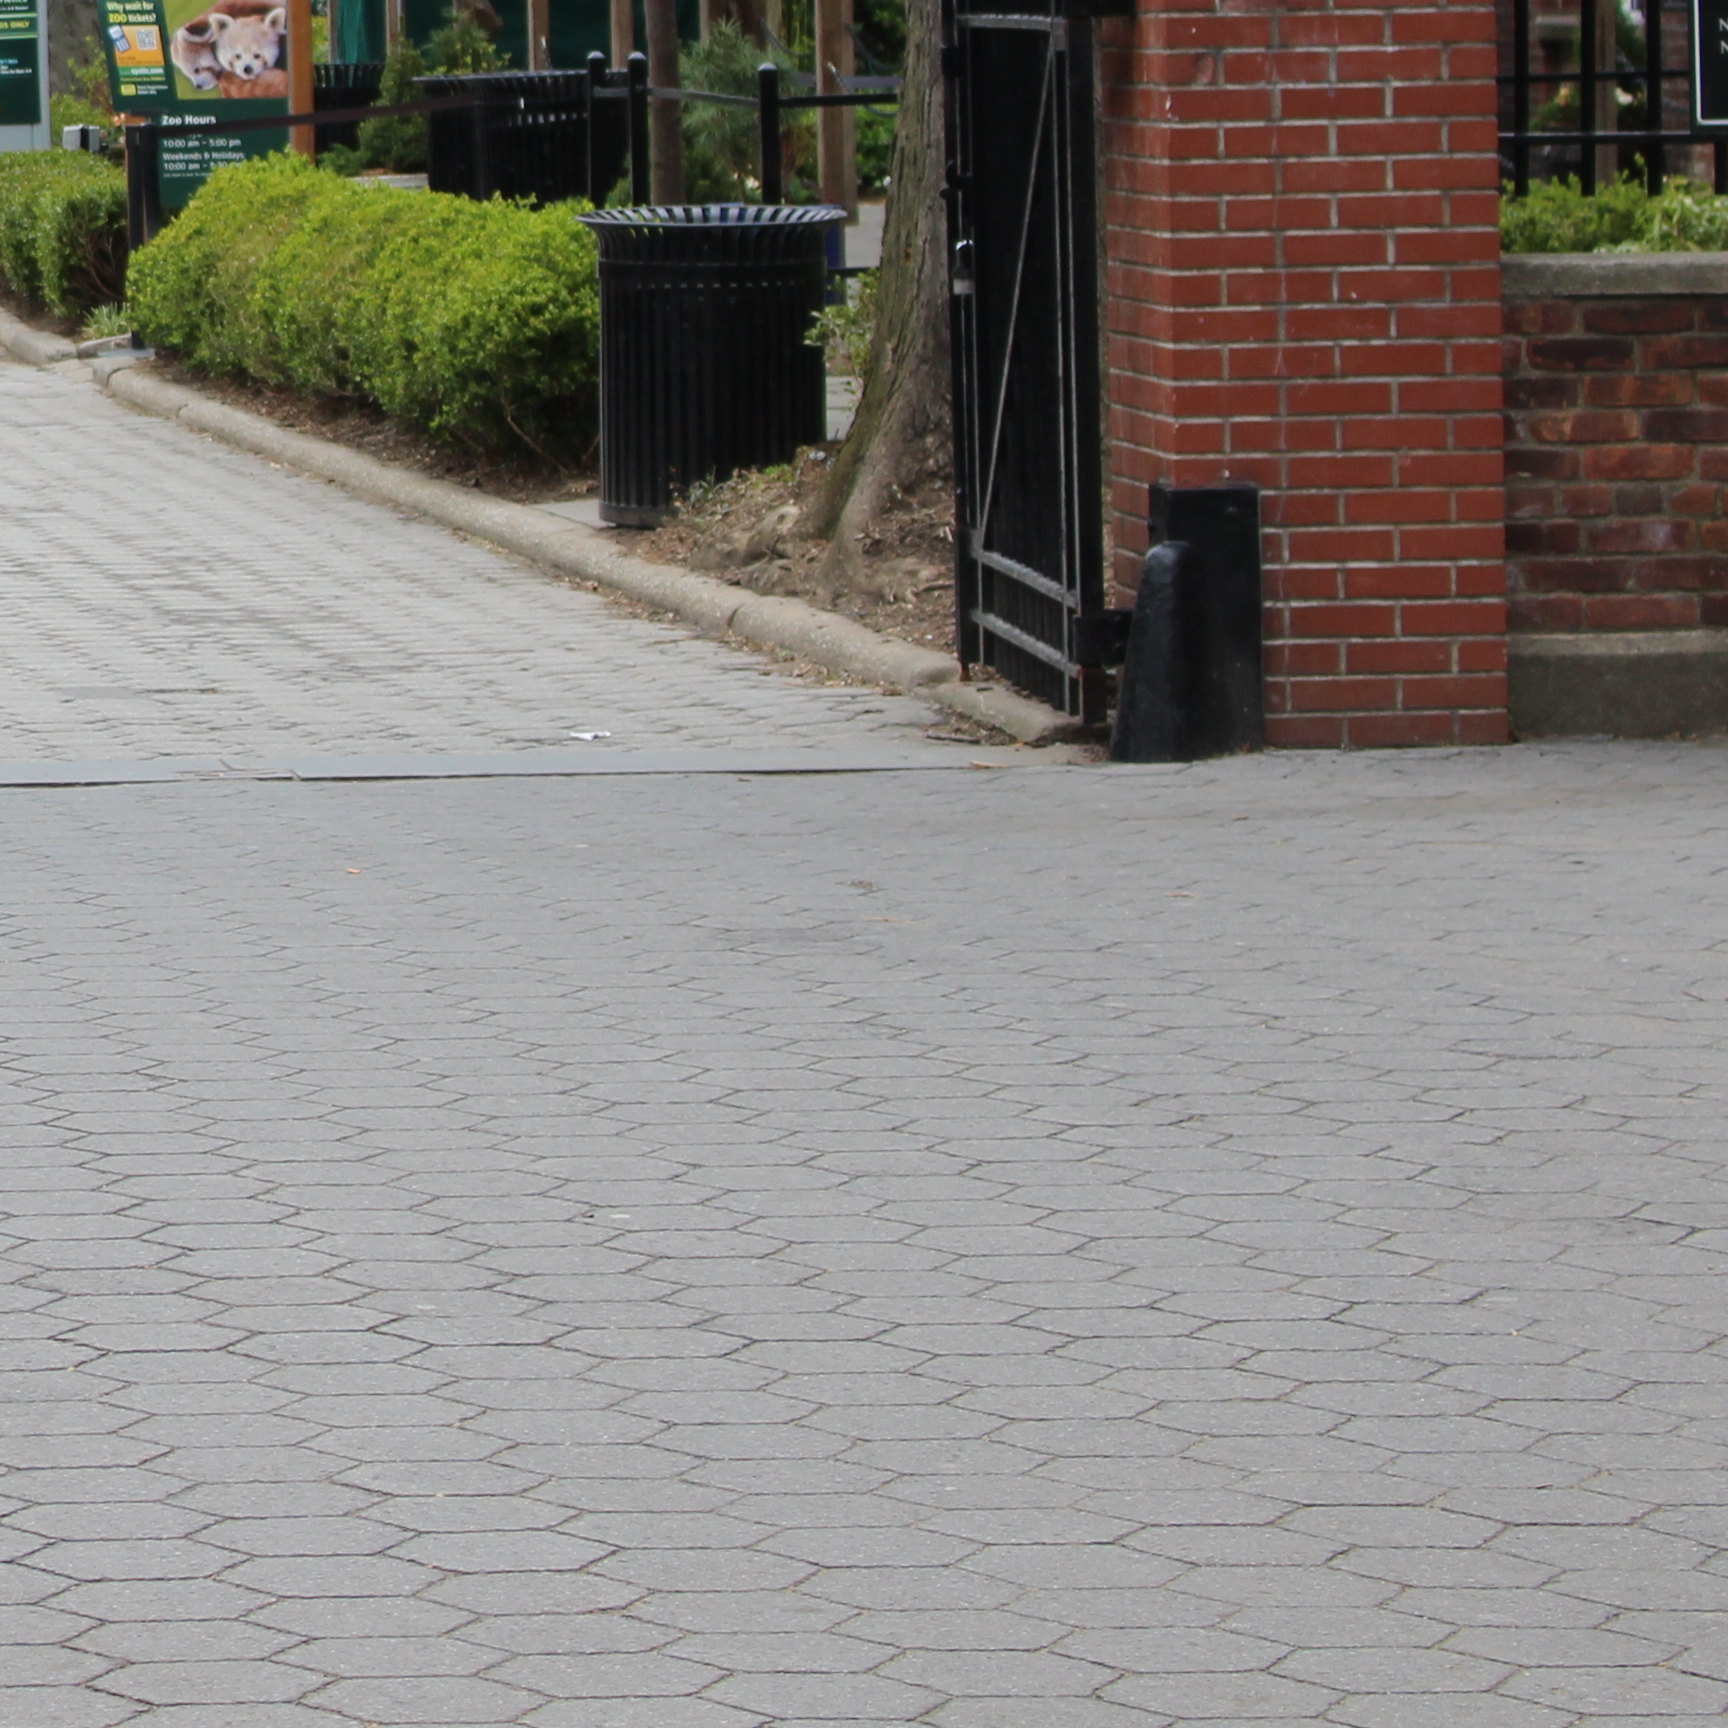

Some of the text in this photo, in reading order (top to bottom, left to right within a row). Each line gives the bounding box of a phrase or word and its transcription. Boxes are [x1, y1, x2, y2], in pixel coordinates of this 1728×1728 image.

[106, 1, 124, 13] Why
[124, 1, 142, 11] wait
[108, 13, 128, 24] ZOO
[10, 20, 30, 29] ONLY
[162, 114, 217, 126] Zoo Hours
[164, 138, 186, 148] 10:00
[187, 139, 201, 148] am
[208, 138, 227, 147] 5:00
[228, 138, 242, 148] pm
[162, 152, 203, 161] Weekends
[211, 150, 245, 161] Holidays
[164, 162, 187, 171] 10:00
[187, 163, 201, 171] am
